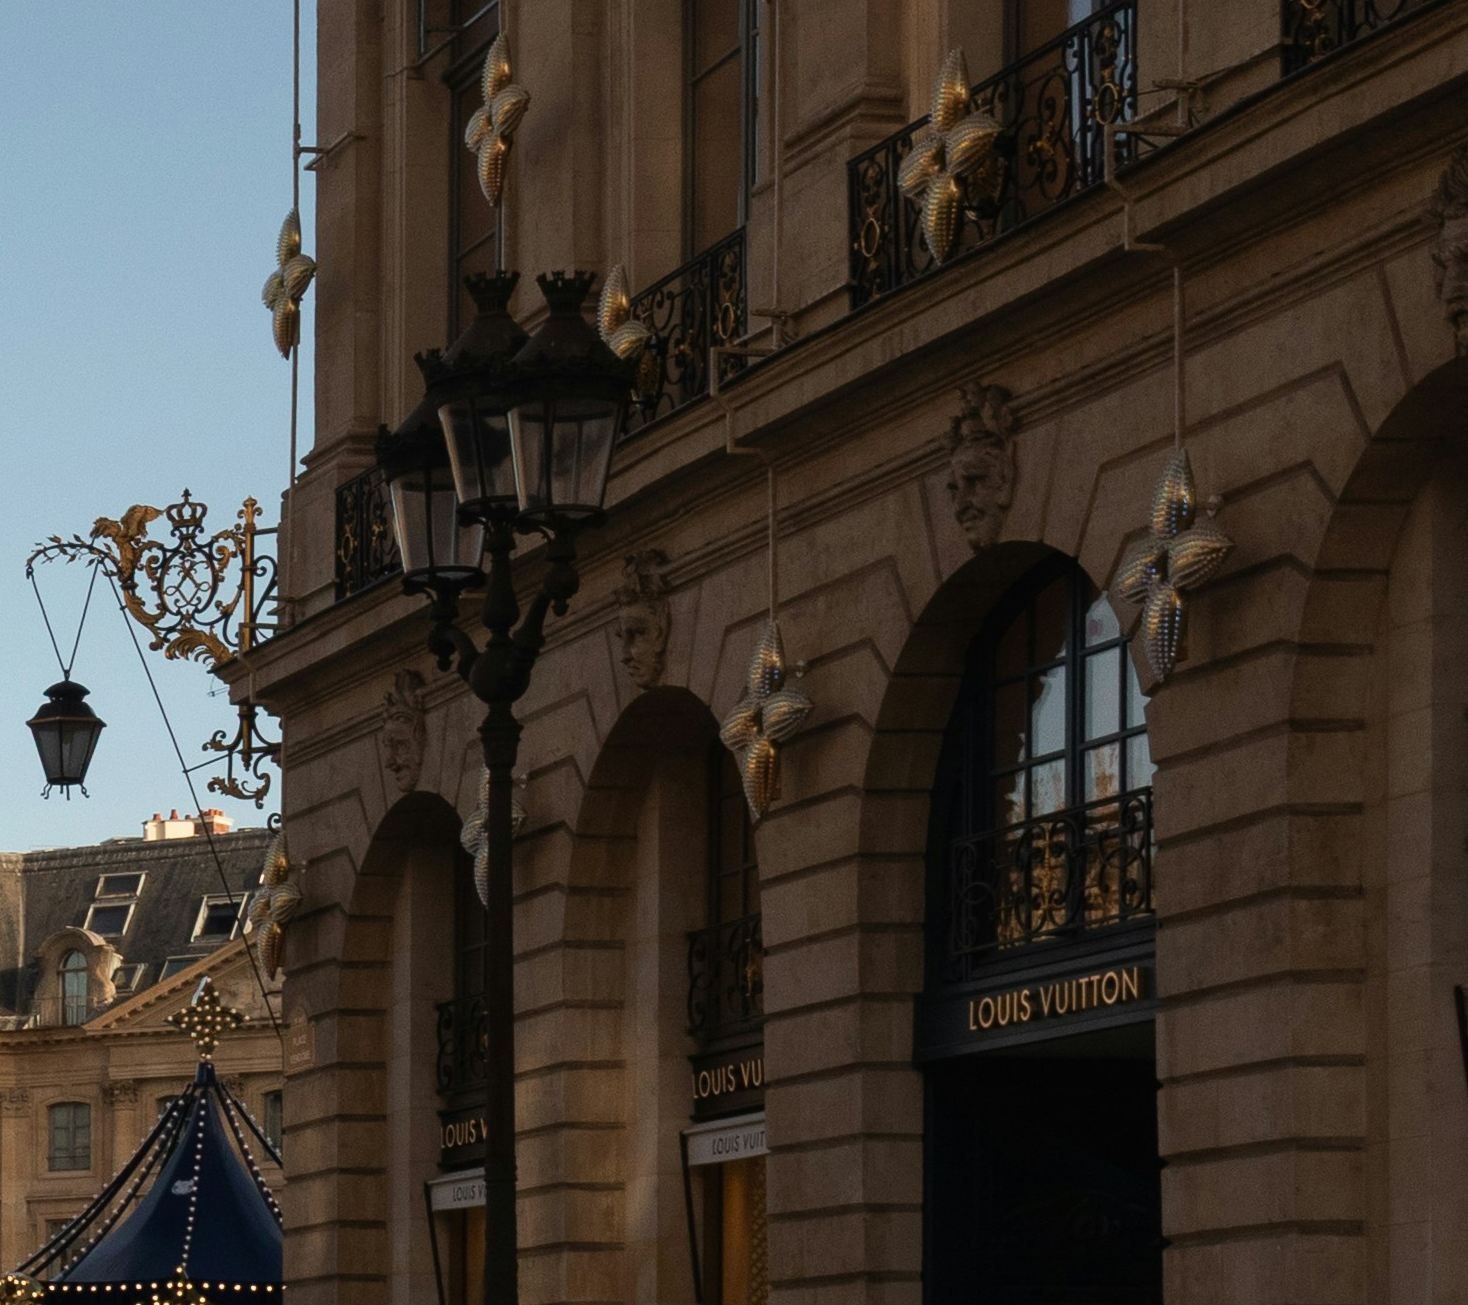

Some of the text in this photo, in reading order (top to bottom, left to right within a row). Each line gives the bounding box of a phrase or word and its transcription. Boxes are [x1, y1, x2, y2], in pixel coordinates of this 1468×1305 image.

[969, 966, 1138, 1031] LOUIS VUITTON
[692, 1064, 736, 1099] LOUIS
[440, 1119, 476, 1149] LOUIS
[712, 1131, 766, 1156] LOUIS VUIT
[452, 1184, 476, 1202] LOUIS
